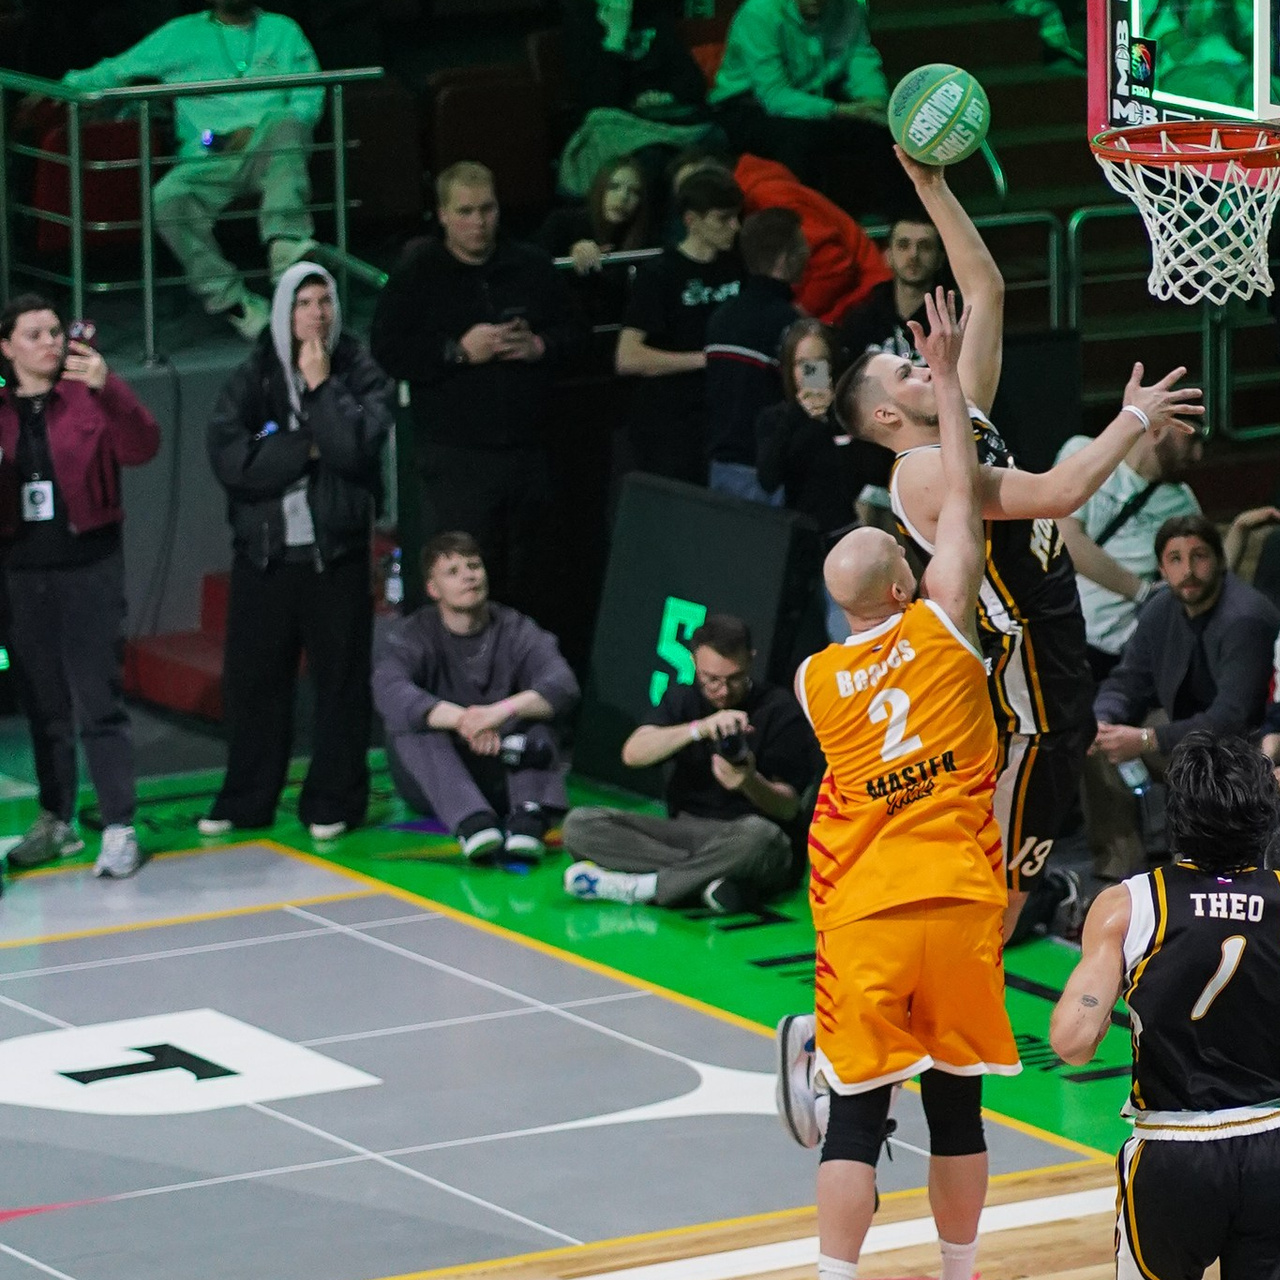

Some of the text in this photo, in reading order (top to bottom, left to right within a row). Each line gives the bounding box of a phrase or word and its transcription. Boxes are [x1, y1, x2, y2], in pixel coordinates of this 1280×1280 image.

[930, 80, 964, 115] MEDIA
[908, 99, 948, 147] BASKET
[867, 687, 923, 763] 2
[865, 750, 958, 802] MASTER
[1008, 835, 1054, 878] 13
[1190, 892, 1265, 923] THEO
[1190, 934, 1247, 1021] 1
